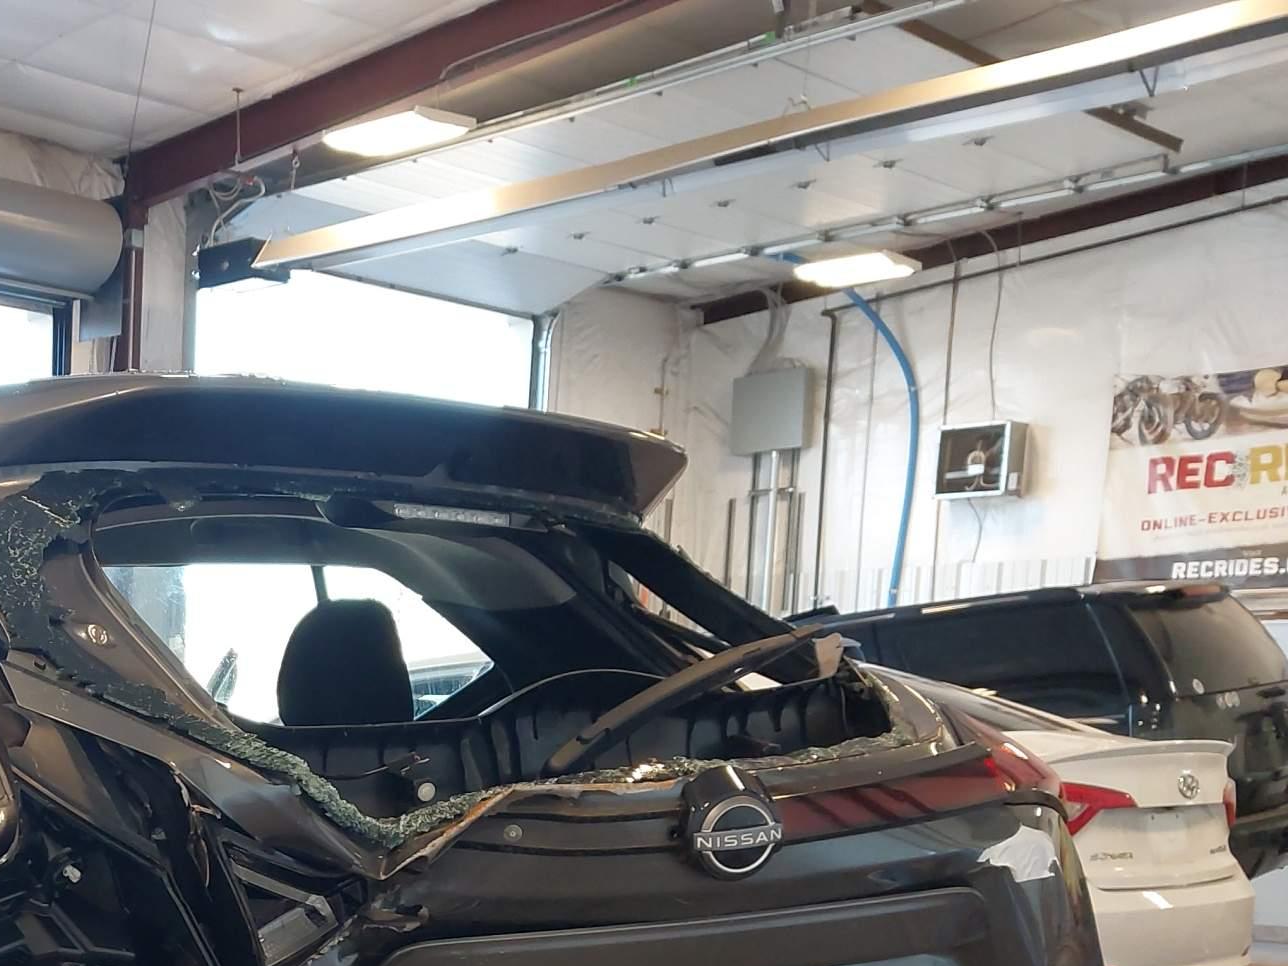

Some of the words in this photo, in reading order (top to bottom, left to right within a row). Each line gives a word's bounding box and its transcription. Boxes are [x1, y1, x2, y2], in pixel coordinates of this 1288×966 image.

[1147, 451, 1236, 494] REC
[1140, 505, 1288, 532] ONLINE-EXCLUSI
[1171, 557, 1288, 579] RECRIDES.
[696, 827, 782, 849] NISSAN
